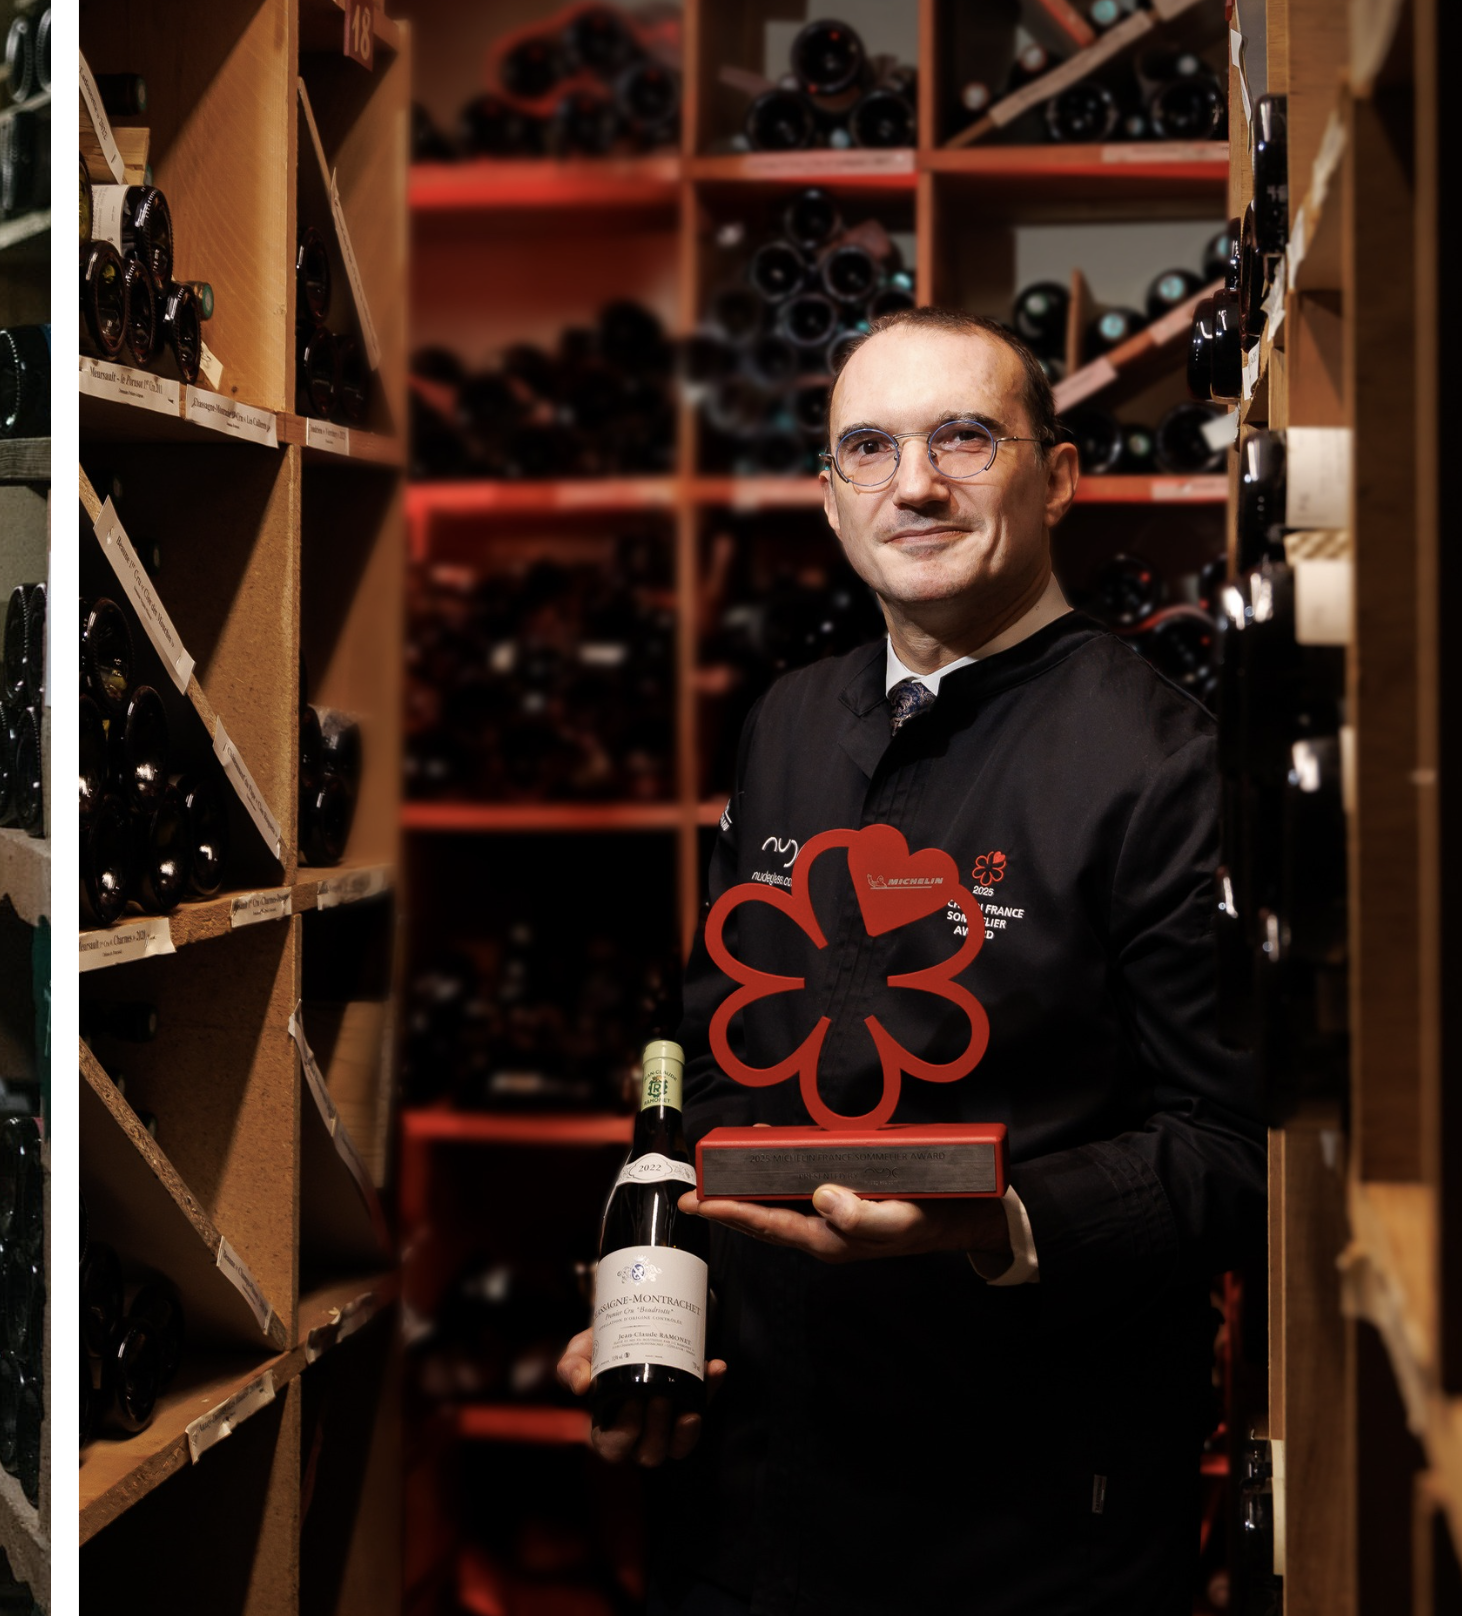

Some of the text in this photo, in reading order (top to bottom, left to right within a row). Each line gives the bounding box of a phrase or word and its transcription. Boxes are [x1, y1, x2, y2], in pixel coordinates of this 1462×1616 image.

[351, 4, 371, 60] 18
[115, 535, 130, 564] Beaune
[134, 570, 142, 588] Cru
[751, 871, 793, 887] nudeglass.co
[888, 877, 943, 885] MICHELIN
[973, 885, 994, 897] 2025
[985, 904, 1025, 918] FRANCE
[946, 910, 1007, 929] SOMLIER
[953, 925, 995, 940] AWD
[750, 1152, 946, 1163] 2025 MICHELIN FRANCE SOMMELIER AWARD
[639, 1163, 662, 1173] 2022
[624, 1306, 634, 1315] Cru
[659, 1332, 692, 1346] RAMONET
